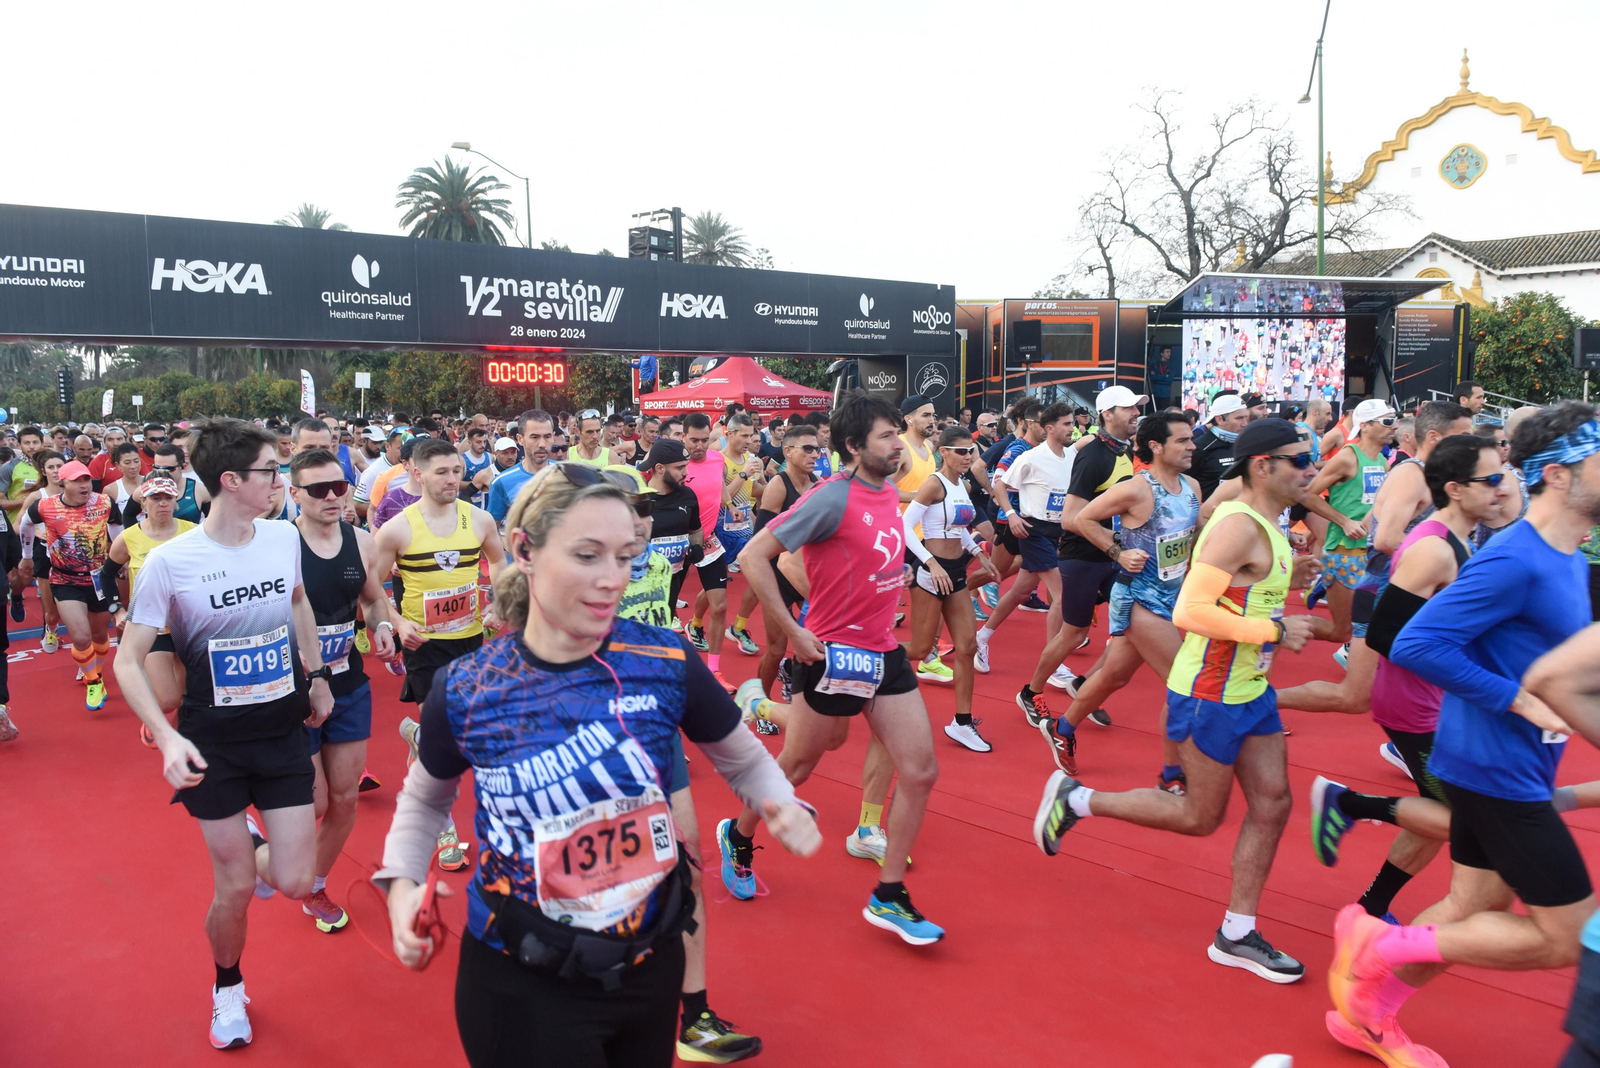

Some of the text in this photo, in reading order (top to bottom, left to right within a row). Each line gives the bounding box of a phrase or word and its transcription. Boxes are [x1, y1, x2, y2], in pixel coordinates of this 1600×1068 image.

[50, 277, 85, 288] Motor
[151, 257, 268, 295] HOKA
[493, 277, 602, 303] maratón
[329, 309, 405, 321] Healthcare Partner
[660, 292, 726, 319] HOKA
[774, 305, 818, 317] HYUNDAI
[510, 325, 586, 339] 28 enero 2024
[848, 332, 871, 340] Healthcare
[488, 362, 564, 383] 00:00:30
[201, 570, 227, 583] GOBIK
[209, 578, 286, 610] LEPAPE
[251, 600, 270, 608] VOTRE
[271, 596, 287, 604] SPORT
[433, 596, 467, 616] 1407
[262, 629, 281, 644] SEVILLA
[224, 649, 278, 676] 2019
[835, 651, 872, 673] 3106
[608, 694, 658, 715] HOKA
[513, 720, 617, 793] MARATÓN
[562, 820, 641, 875] 1375
